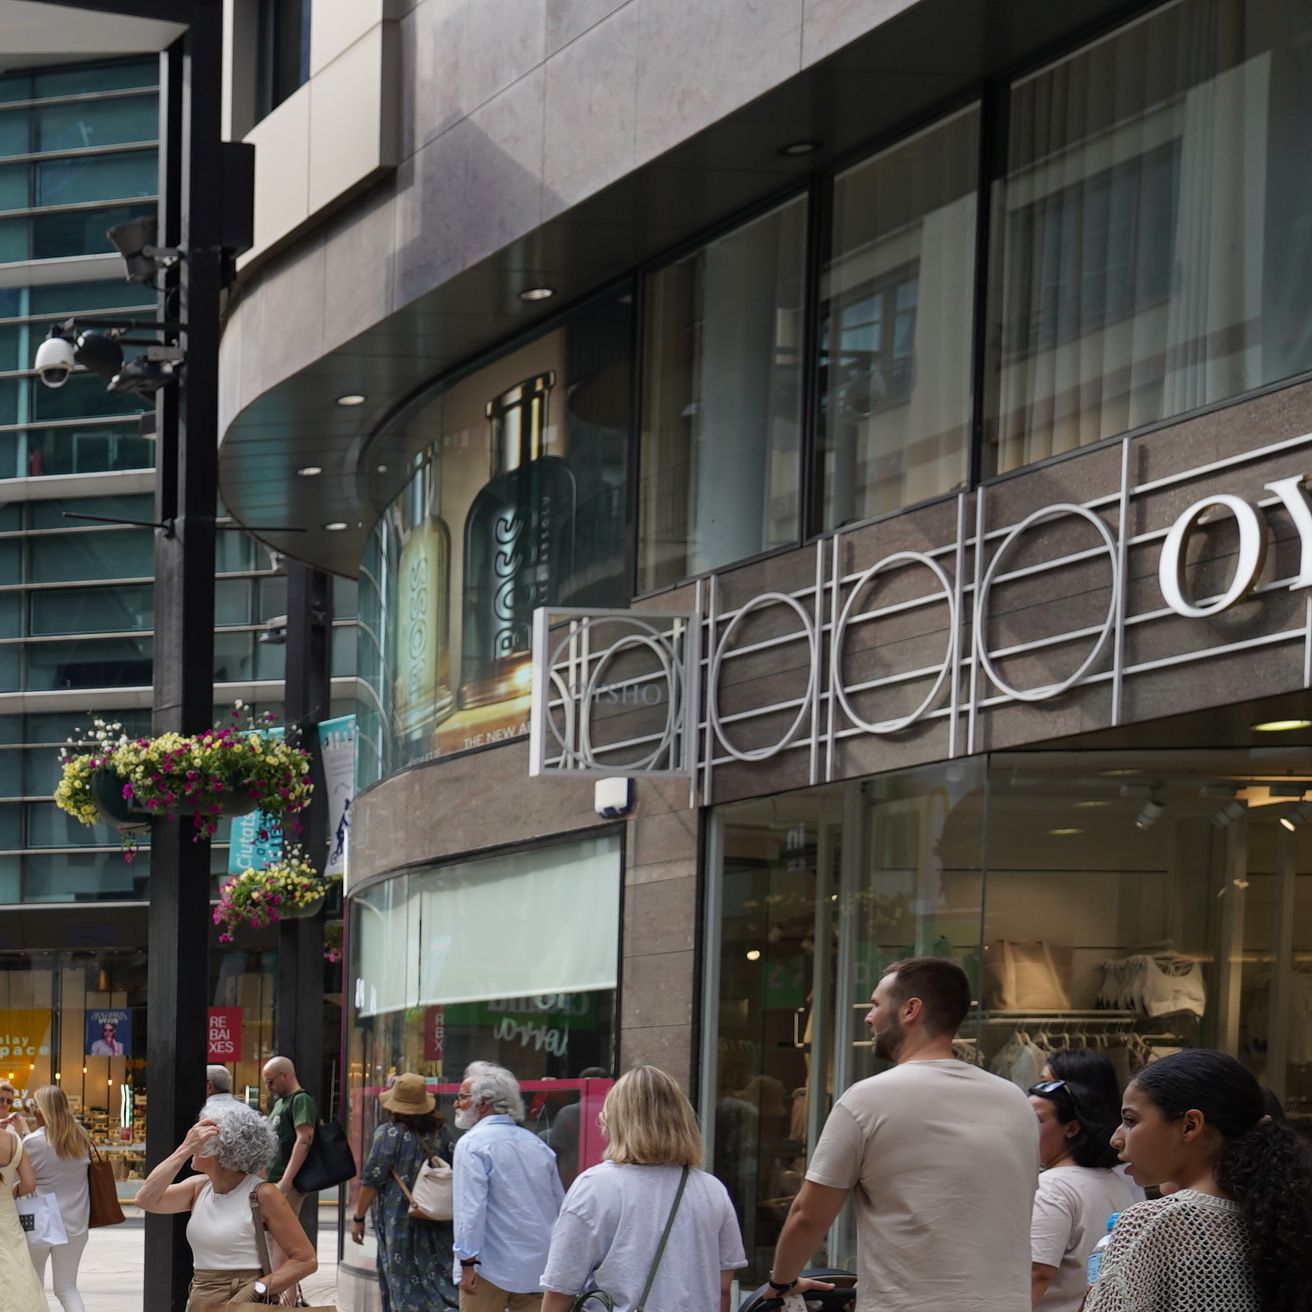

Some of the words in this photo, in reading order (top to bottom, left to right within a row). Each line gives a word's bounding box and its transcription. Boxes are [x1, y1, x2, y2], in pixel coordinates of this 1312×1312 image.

[209, 1015, 226, 1029] RE
[209, 1028, 231, 1040] BAI
[209, 1041, 234, 1054] XES
